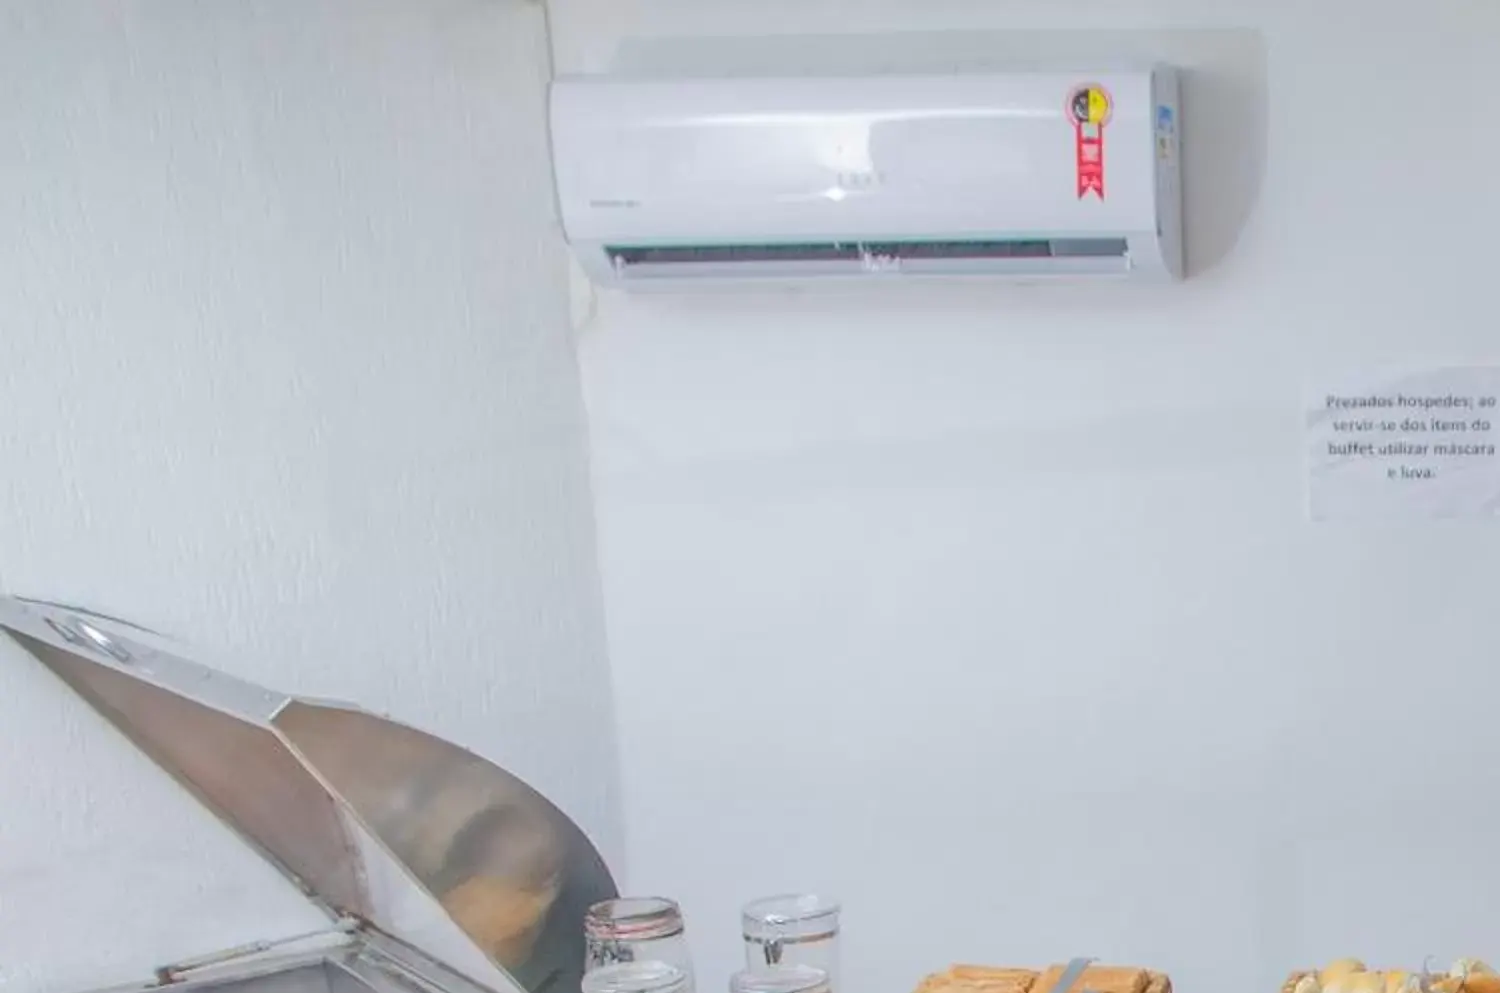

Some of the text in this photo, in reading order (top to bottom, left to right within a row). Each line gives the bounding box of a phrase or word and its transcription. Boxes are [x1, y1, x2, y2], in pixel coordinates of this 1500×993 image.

[1325, 395, 1394, 408] Prezados
[1478, 397, 1497, 408] ao
[1332, 418, 1492, 432] servir-se dos itens do
[1327, 442, 1375, 456] buffet
[1378, 442, 1430, 456] utilizar
[1386, 468, 1397, 480] e
